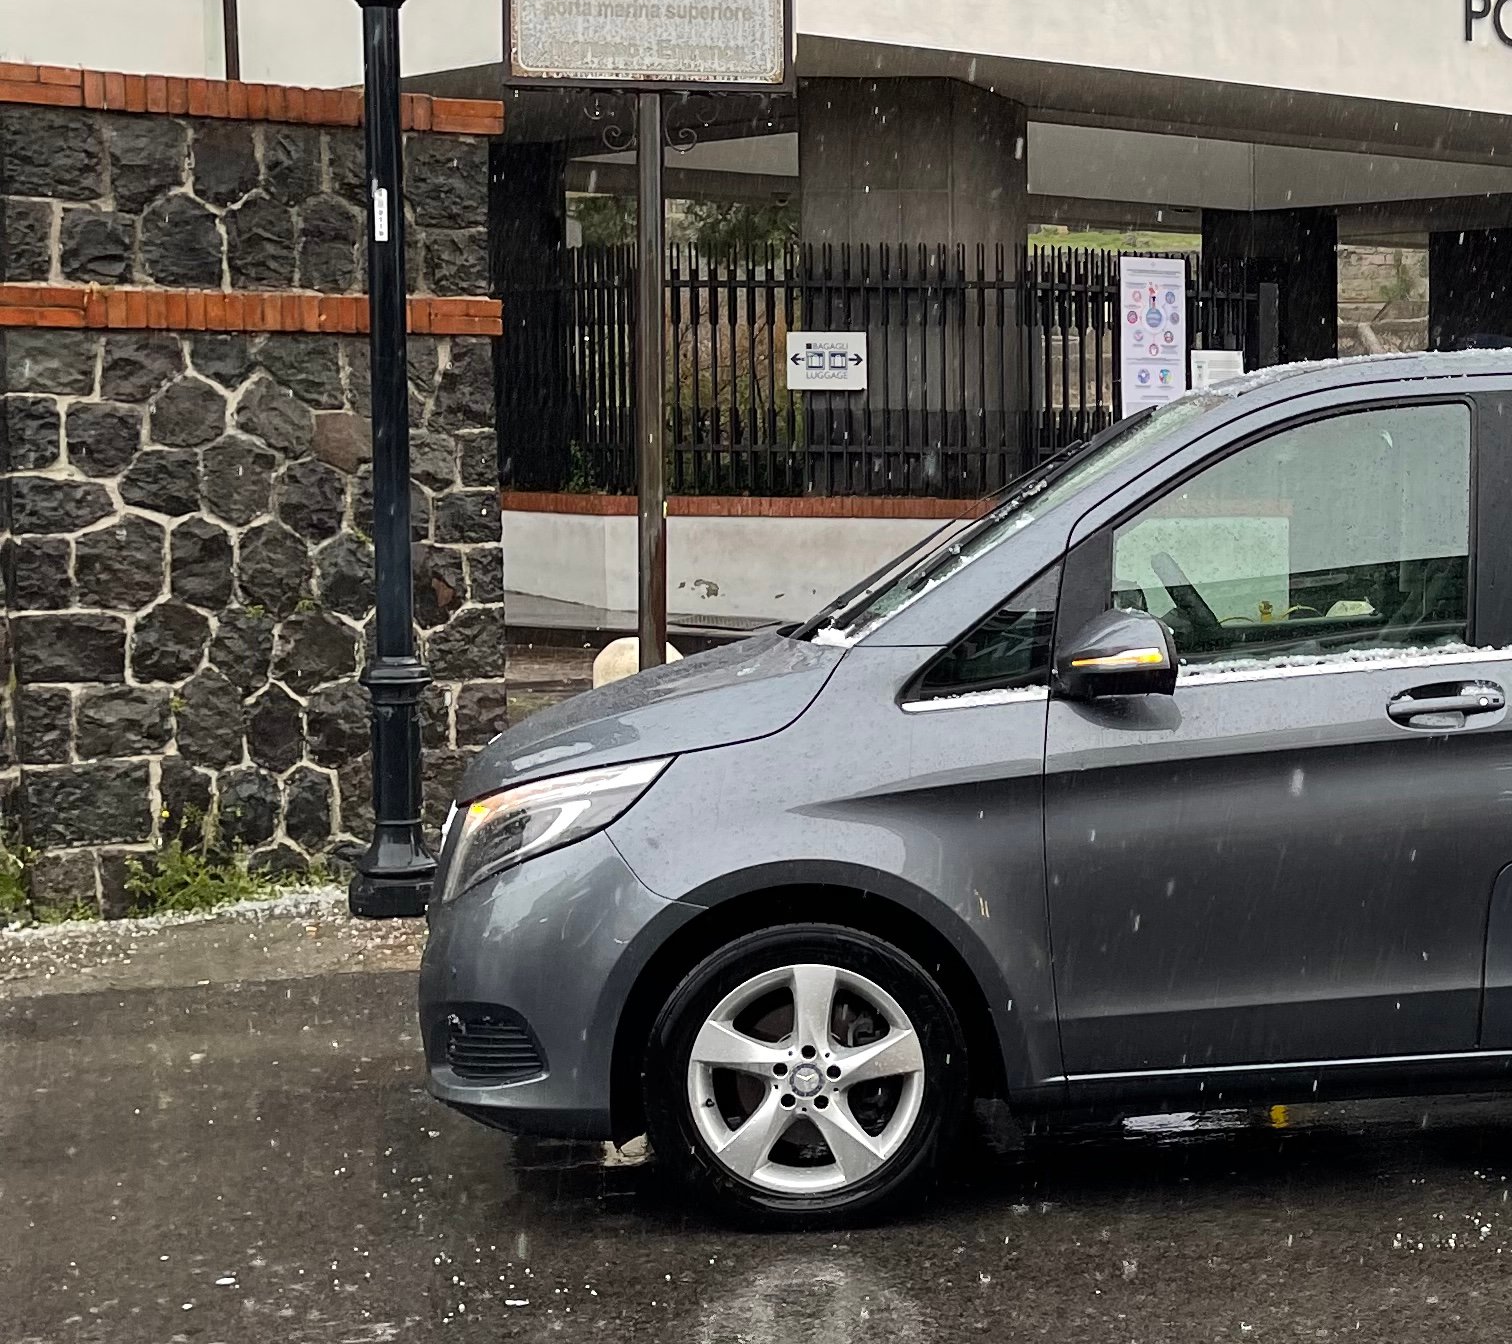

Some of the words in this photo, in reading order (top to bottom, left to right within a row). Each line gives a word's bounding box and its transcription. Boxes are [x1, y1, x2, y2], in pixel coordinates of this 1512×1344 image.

[597, 0, 660, 20] marina
[664, 0, 753, 23] superiore
[812, 342, 849, 350] BAGAGLI
[806, 371, 848, 380] LUGGAGE
